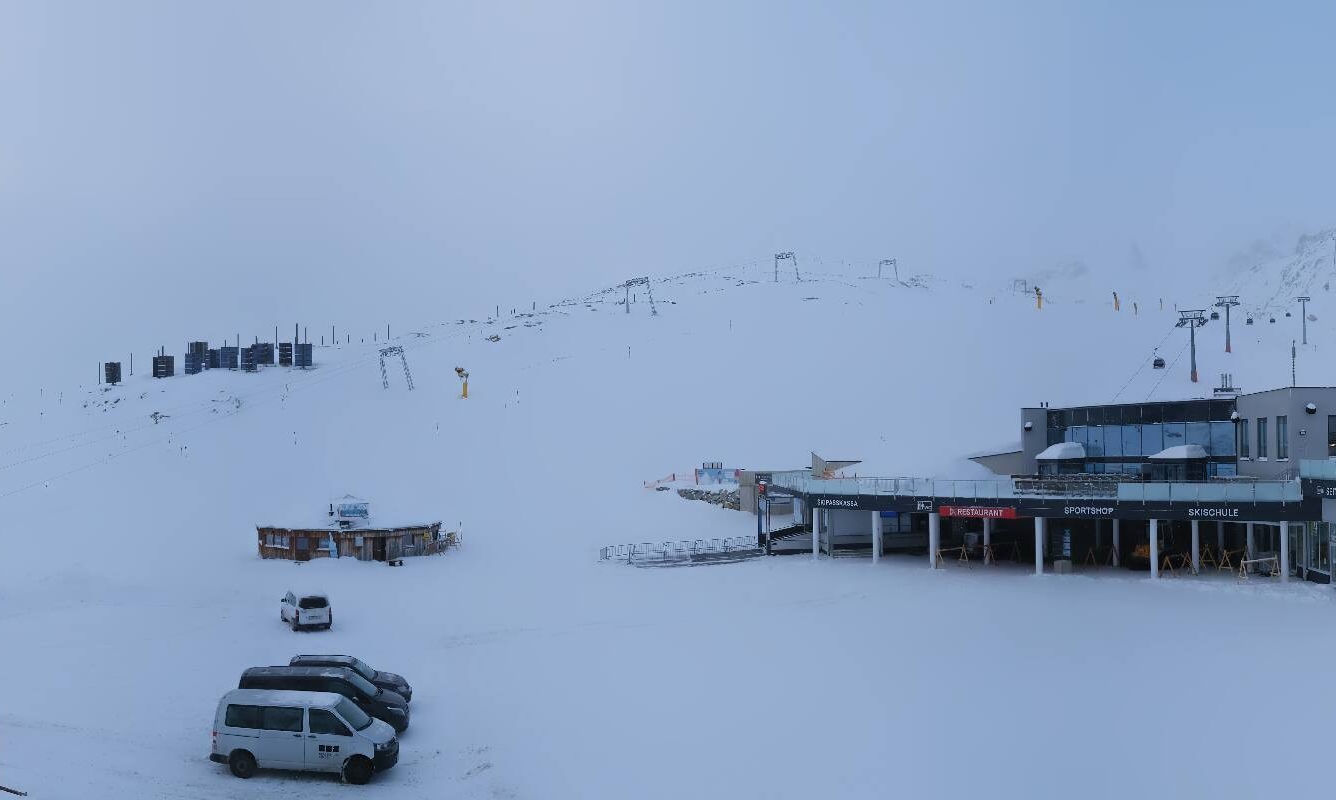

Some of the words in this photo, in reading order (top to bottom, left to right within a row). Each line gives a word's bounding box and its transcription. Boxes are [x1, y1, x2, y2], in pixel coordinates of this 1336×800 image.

[957, 508, 1003, 517] RESTAURANT
[1064, 506, 1114, 515] SPORTSHOP
[1188, 508, 1239, 517] SKISCHULE
